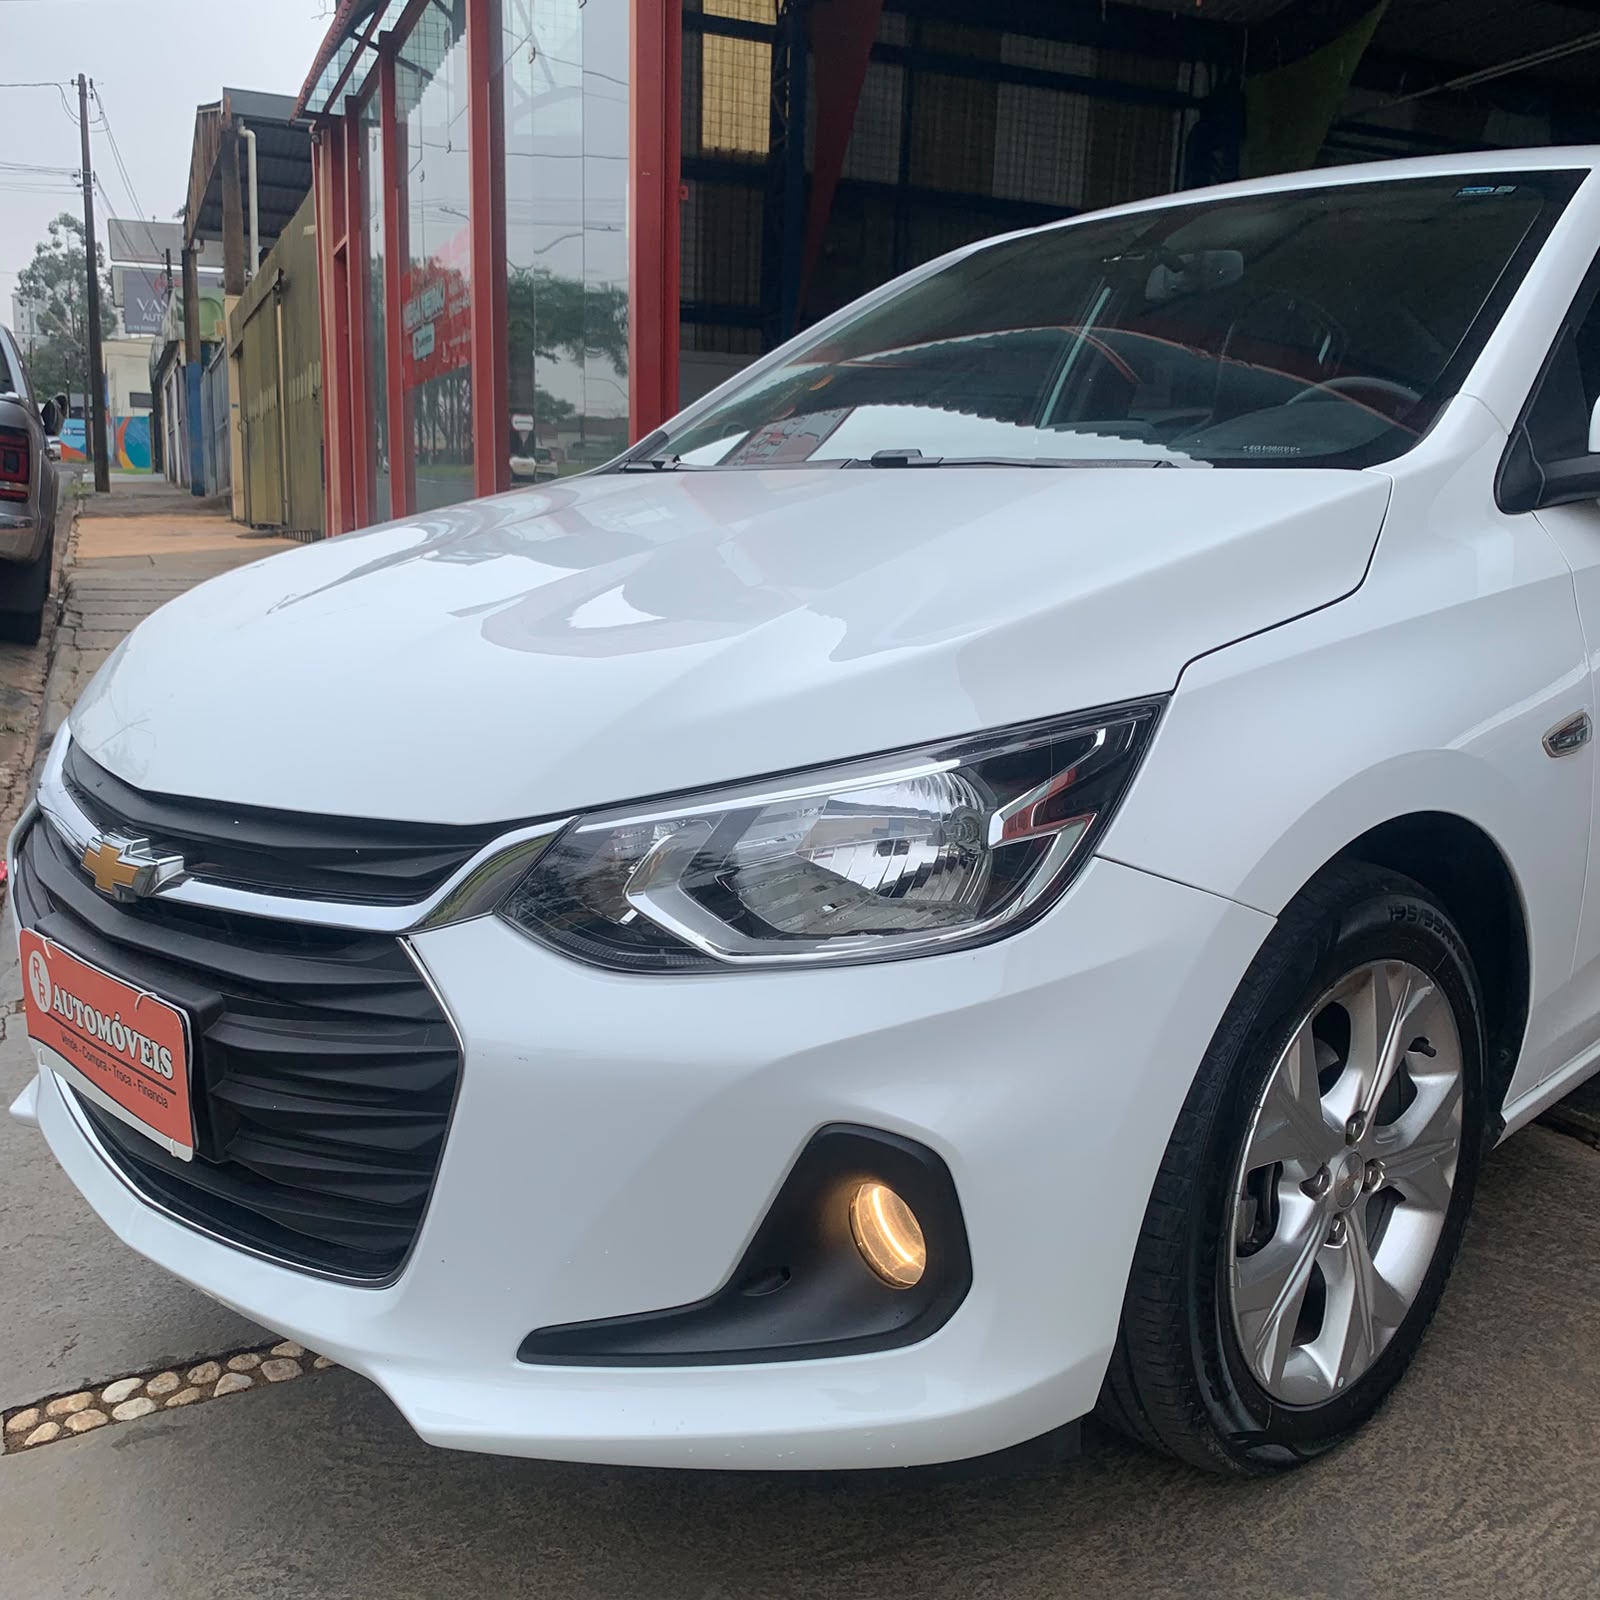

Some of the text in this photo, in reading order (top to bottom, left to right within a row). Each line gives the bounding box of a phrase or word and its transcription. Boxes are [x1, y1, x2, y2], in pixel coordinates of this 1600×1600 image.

[53, 984, 174, 1080] AUTOMÓVEIS
[82, 1046, 107, 1072] Compra
[112, 1064, 132, 1087] Troca
[137, 1079, 168, 1109] Financia
